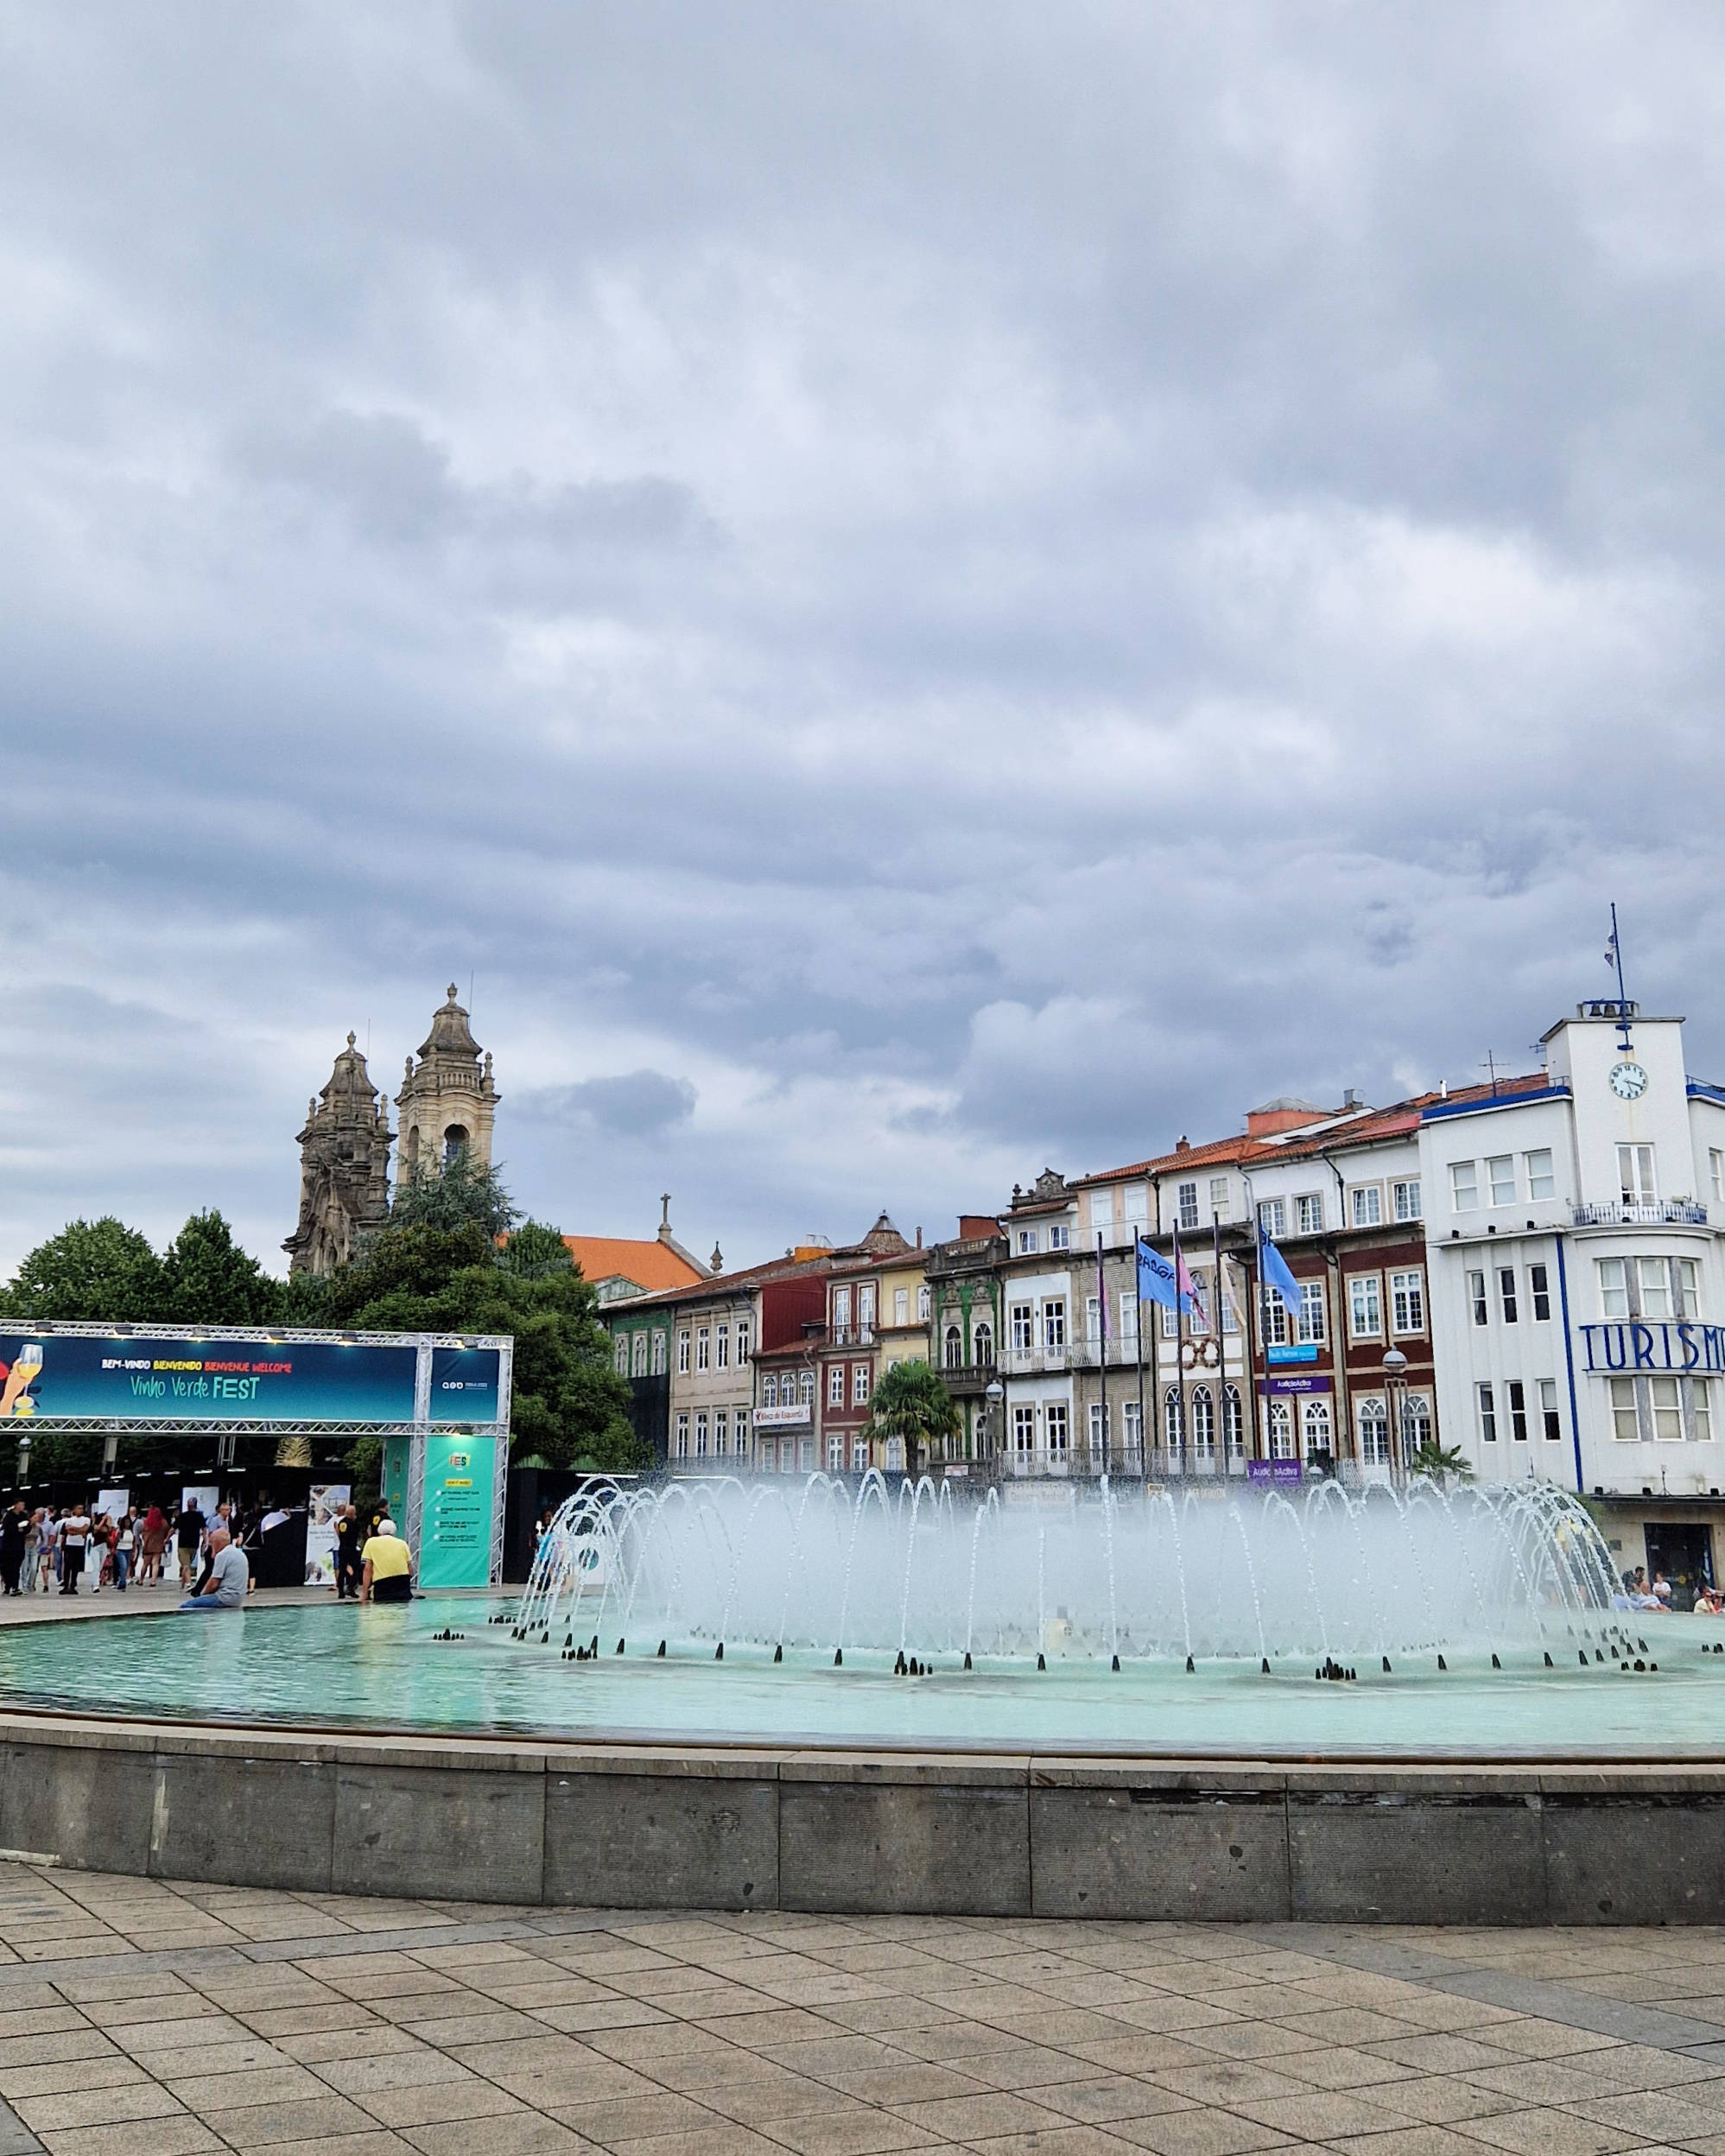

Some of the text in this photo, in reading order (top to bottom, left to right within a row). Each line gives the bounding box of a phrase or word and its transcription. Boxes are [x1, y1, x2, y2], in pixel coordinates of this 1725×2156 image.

[1579, 1323, 1725, 1370] TURISM
[101, 1359, 150, 1369] BEM-VINDO
[204, 1361, 249, 1372] BIENVENUE
[252, 1362, 292, 1373] WELCOME
[130, 1376, 260, 1400] Vinho Verde FEST
